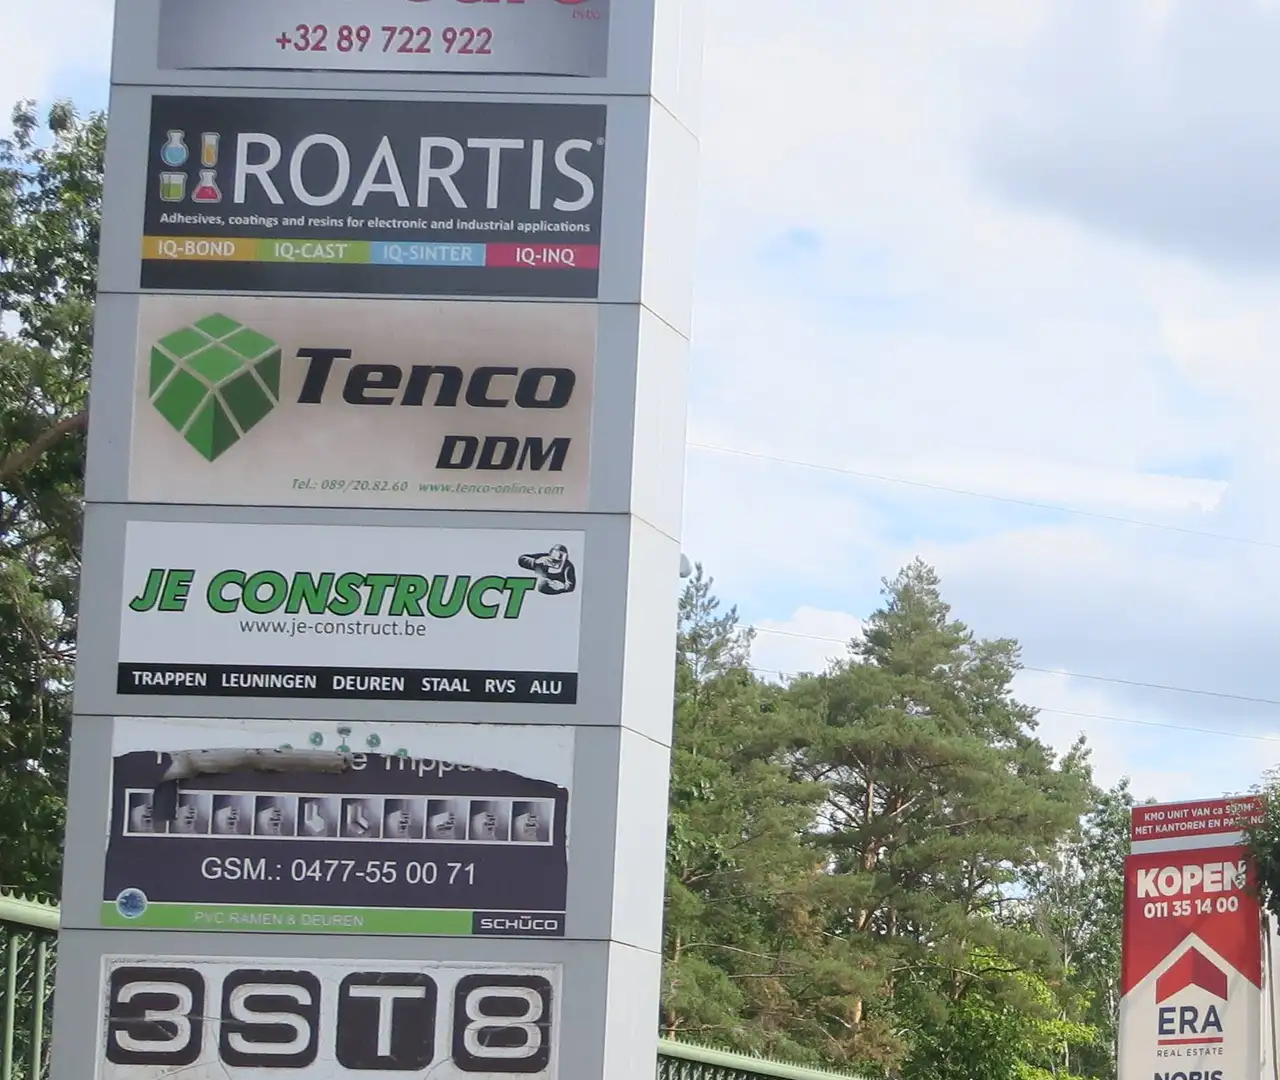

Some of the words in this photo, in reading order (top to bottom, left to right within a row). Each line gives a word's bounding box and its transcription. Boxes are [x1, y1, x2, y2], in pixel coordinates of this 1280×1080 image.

[275, 24, 328, 52] +32
[335, 24, 371, 53] 89
[381, 26, 432, 53] 722
[441, 27, 493, 54] 922
[160, 213, 226, 226] Adhesives,
[228, 214, 278, 228] coatings
[282, 215, 305, 227] and
[308, 216, 344, 227] resins
[347, 216, 365, 227] for
[367, 217, 427, 229] electronic
[430, 218, 453, 230] and
[456, 219, 514, 231] industrial
[517, 220, 591, 233] applications
[158, 240, 235, 257] IQ-BOND
[275, 242, 347, 259] IQ-CAST
[383, 244, 472, 264] IQ-SINTER
[515, 247, 576, 267] IQ-INQ
[295, 347, 577, 409] Tenco
[435, 435, 572, 471] DDM
[321, 479, 408, 493] 089/20.82.60
[418, 482, 565, 495] www.tenco-online.com
[129, 568, 196, 612] JE
[206, 569, 538, 619] CONSTRUCT
[239, 618, 427, 636] www.je-construct.be
[132, 670, 207, 688] TRAPPEN
[221, 672, 317, 690] LEUNINGEN
[332, 675, 405, 692] DEUREN
[421, 676, 471, 693] STAAL
[484, 677, 516, 694] RVS
[529, 679, 563, 695] ALU
[1144, 811, 1165, 822] KMO
[1167, 809, 1189, 820] UNIT
[1191, 807, 1211, 818] VAN
[1212, 807, 1223, 816] ca
[1135, 825, 1153, 835] MET
[1155, 820, 1206, 834] KANTOREN
[1208, 818, 1221, 829] EN
[200, 856, 282, 882] GSM.:
[290, 858, 397, 884] 0477-55
[405, 860, 438, 885] 00
[446, 862, 477, 886] 71
[1137, 860, 1247, 898] KOPEN
[1144, 901, 1168, 919] 011
[1172, 899, 1192, 917] 35
[1195, 898, 1212, 915] 14
[1216, 896, 1239, 913] 00
[193, 911, 225, 924] PVC
[229, 912, 282, 926] RAMEN
[286, 914, 297, 926] &
[301, 914, 365, 927] DEUREN
[480, 915, 558, 931] SCHÜCO
[111, 976, 547, 1063] 3ST8
[1158, 1004, 1223, 1035] ERA
[1157, 1049, 1182, 1058] REAL
[1186, 1047, 1223, 1057] ESTATE
